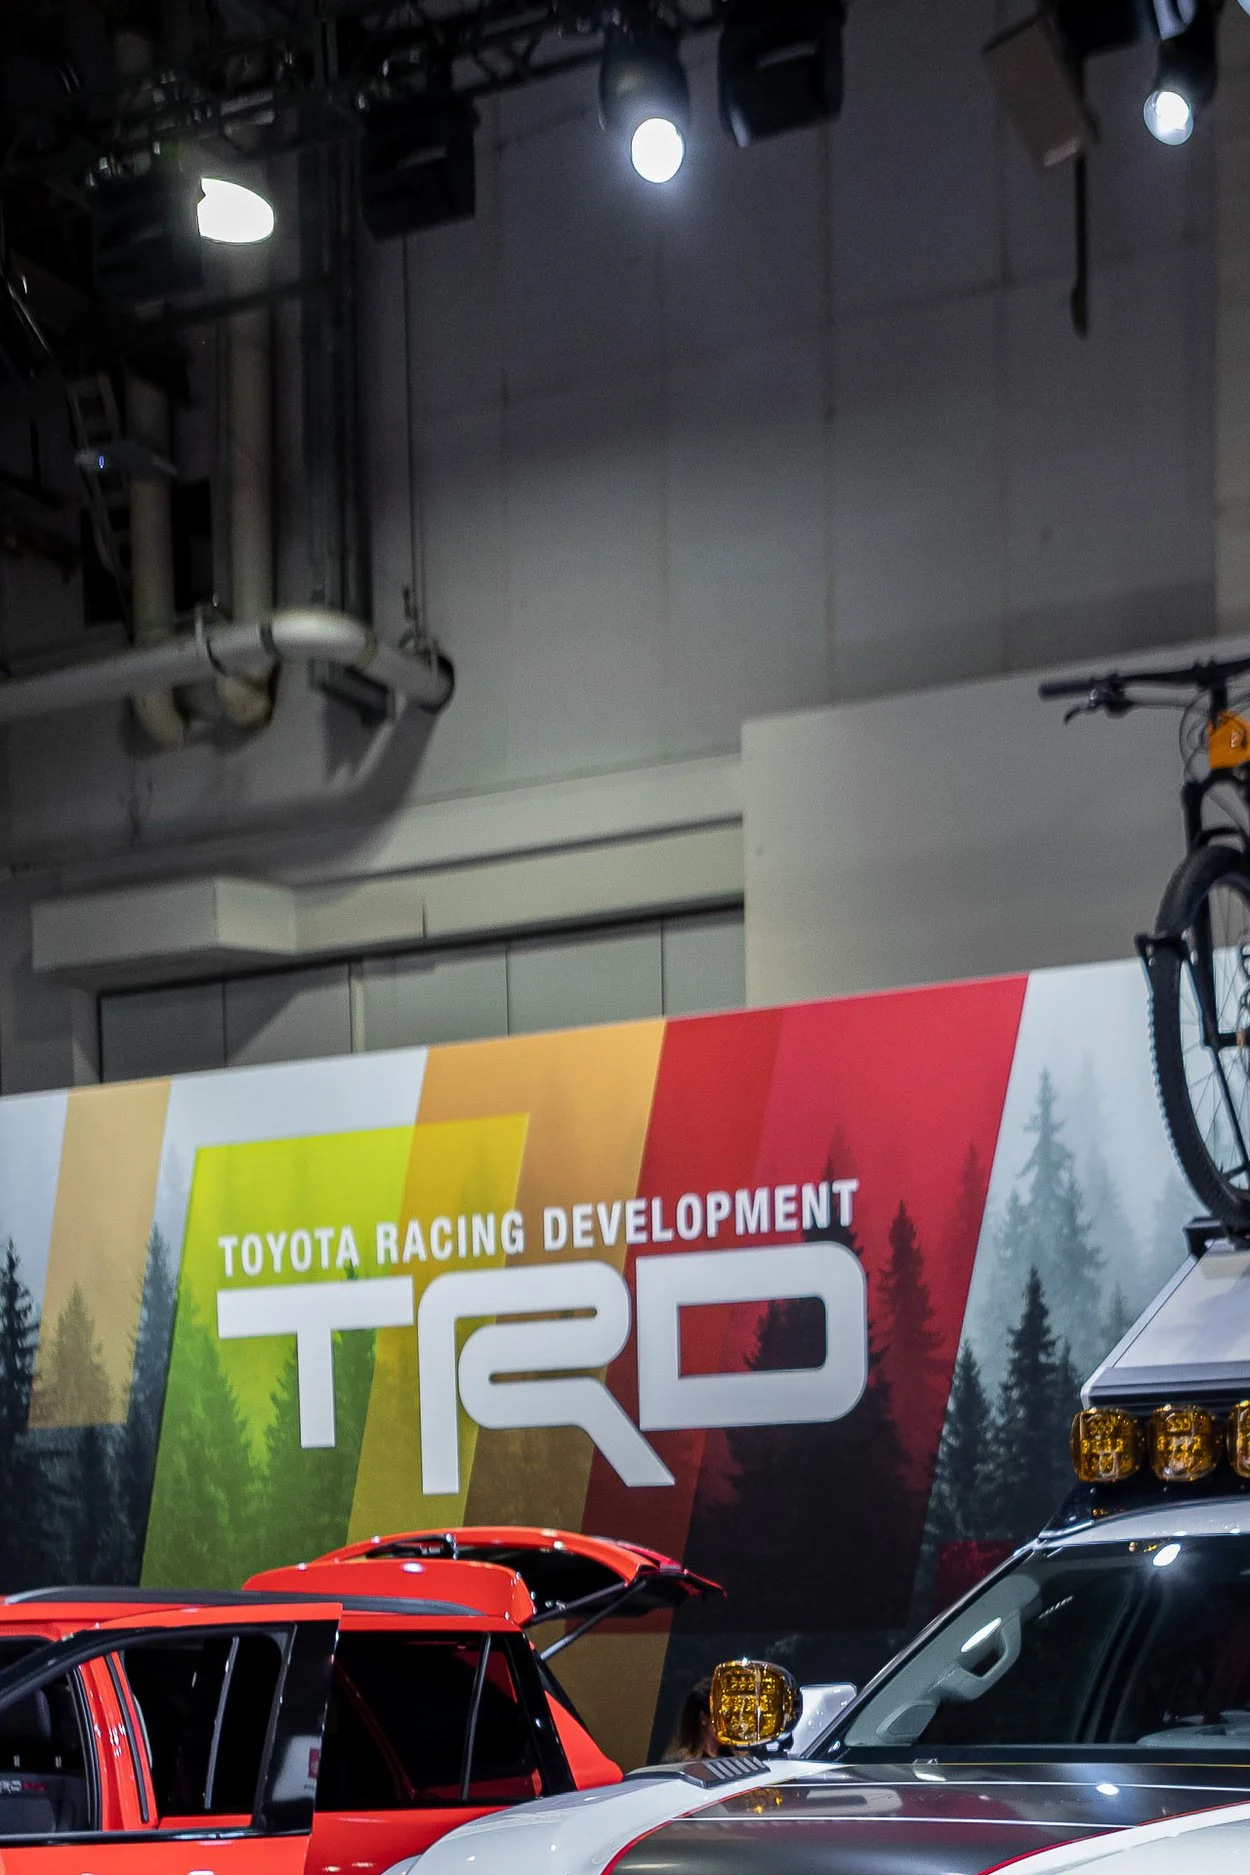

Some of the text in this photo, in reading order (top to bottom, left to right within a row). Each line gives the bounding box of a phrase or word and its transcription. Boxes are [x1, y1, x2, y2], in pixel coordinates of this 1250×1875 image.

[218, 1178, 861, 1278] TOYOTA RACING DEVELOPMENT
[216, 1240, 869, 1497] TRD
